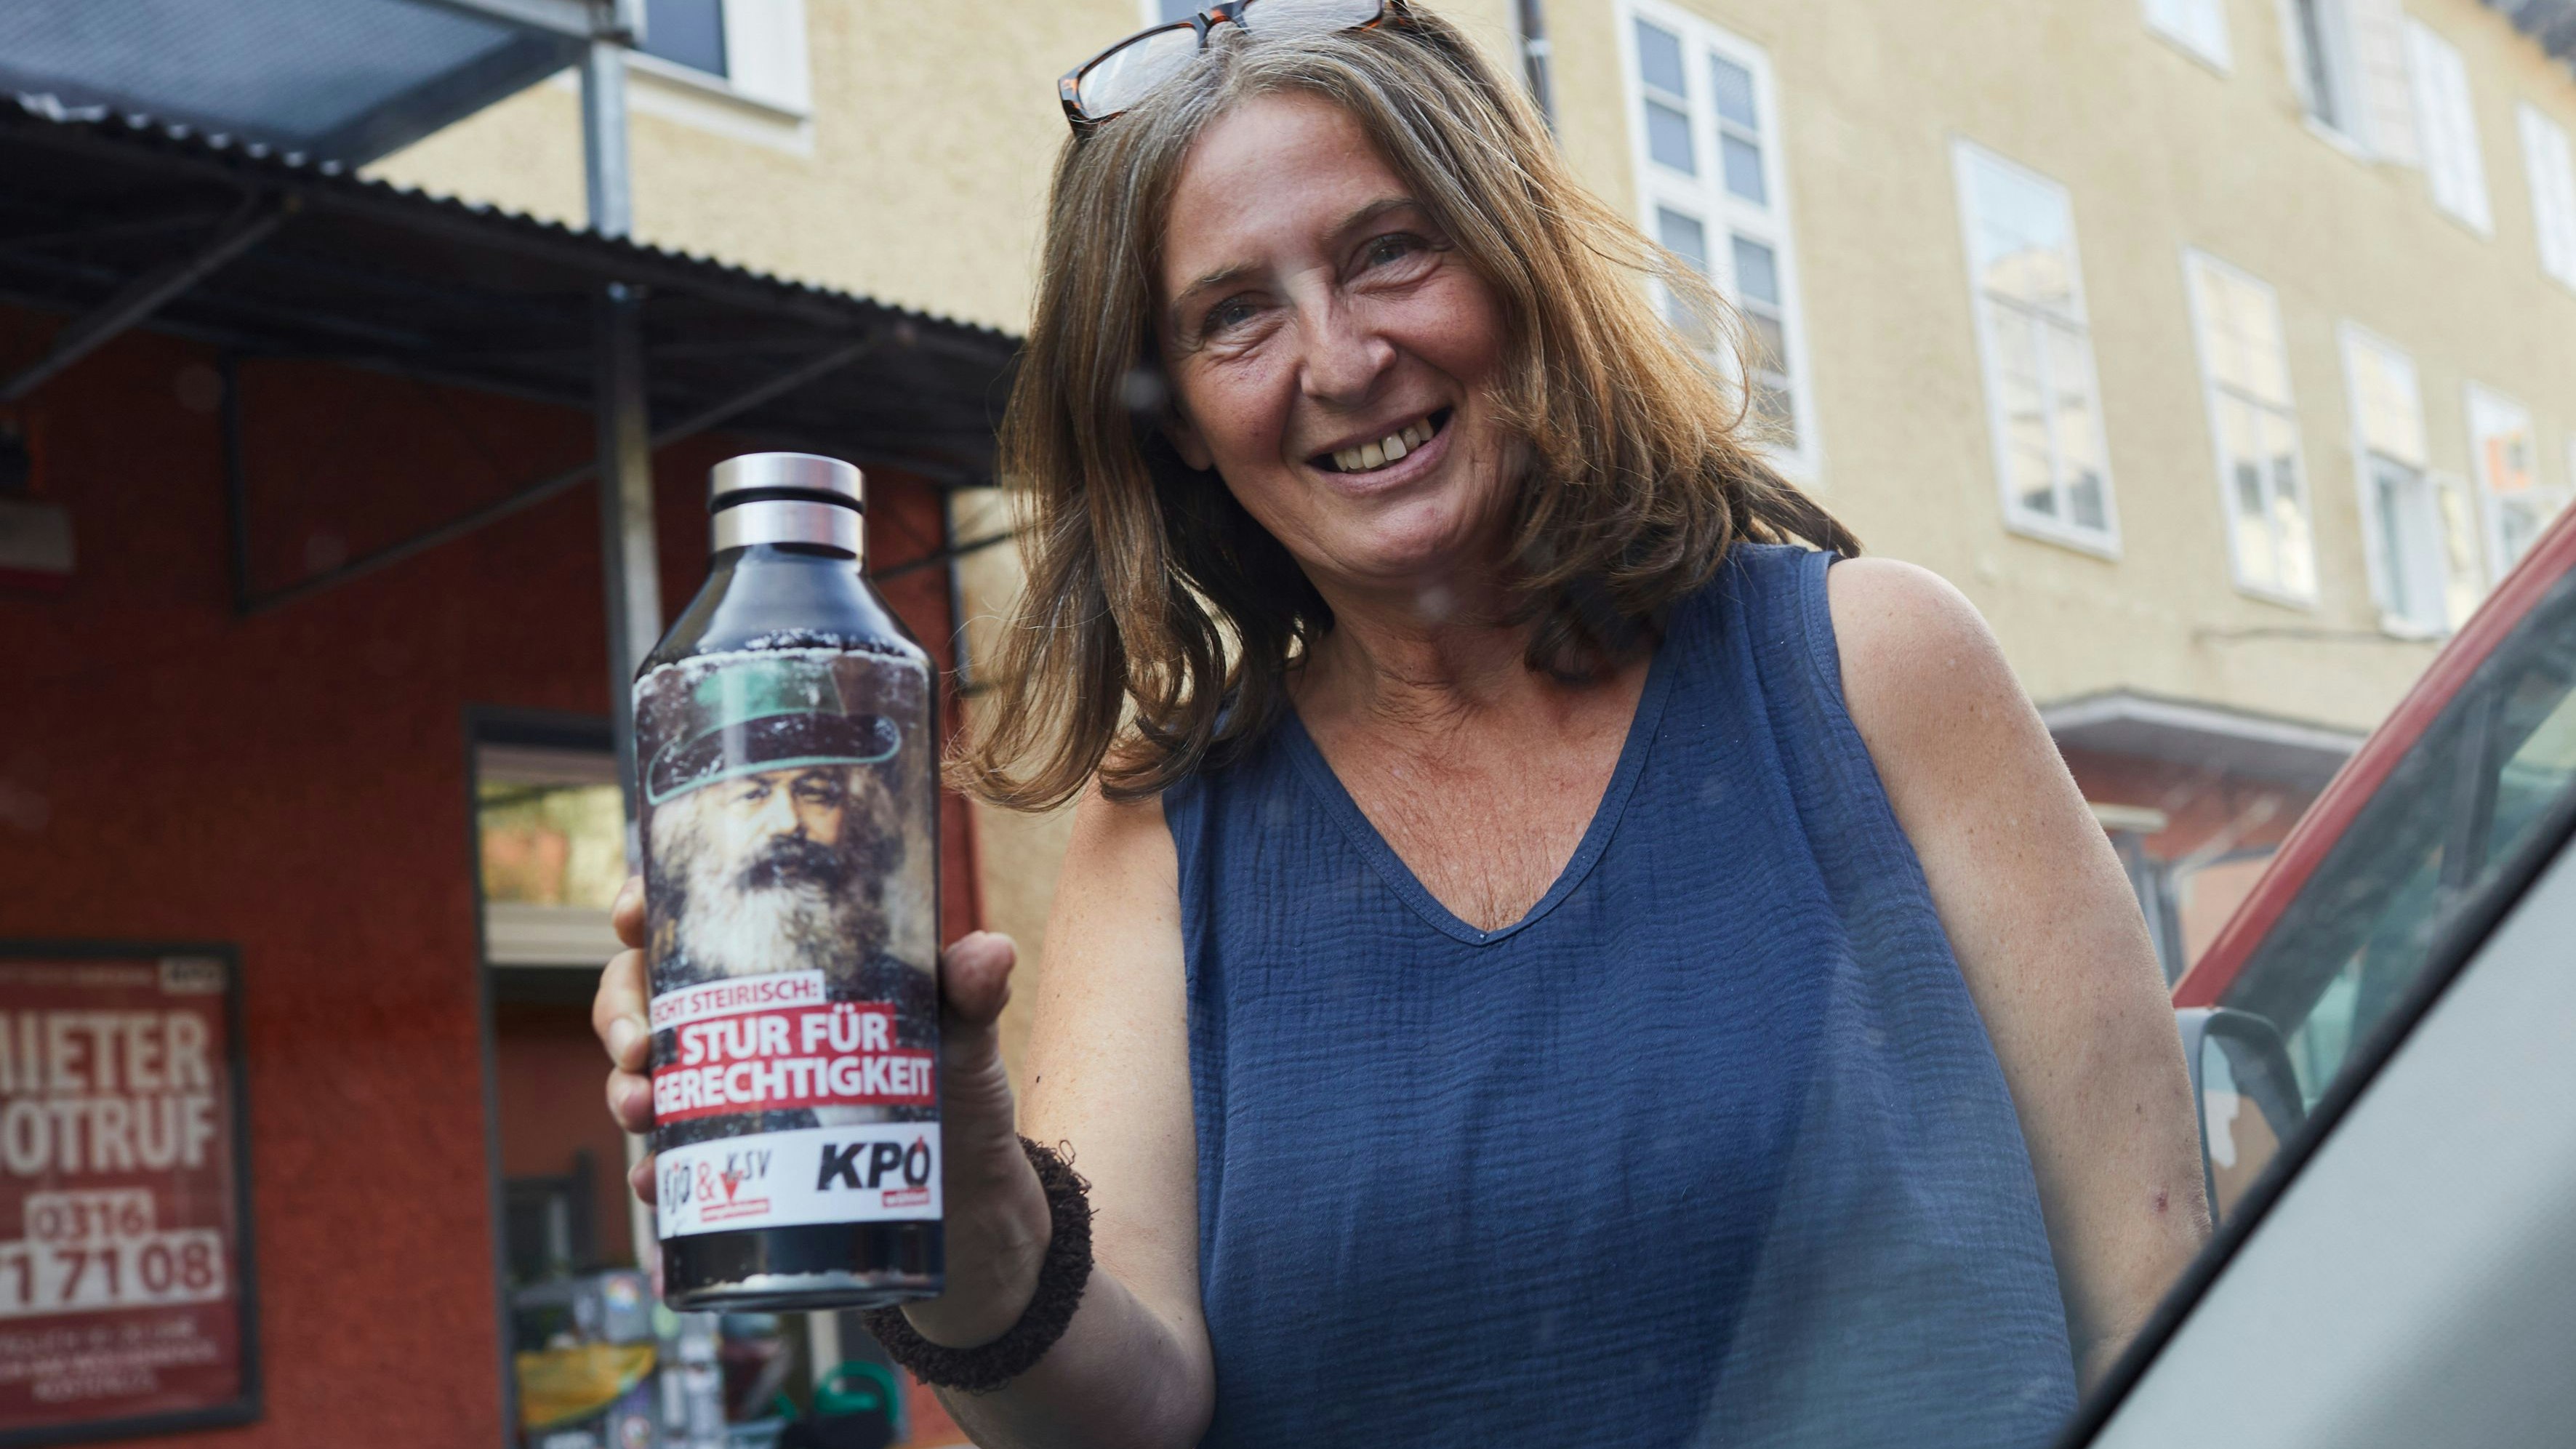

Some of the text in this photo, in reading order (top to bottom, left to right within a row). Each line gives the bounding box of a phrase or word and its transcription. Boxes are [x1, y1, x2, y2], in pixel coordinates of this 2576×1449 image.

[691, 979, 819, 1012] STEIRISCH:
[681, 1004, 891, 1065] STUR FÜR
[655, 1056, 932, 1115] GERECHTIGKEIT
[0, 1096, 217, 1173] OTRUF
[696, 1161, 715, 1201] &
[727, 1148, 771, 1181] KSV
[35, 1200, 145, 1242] 0316
